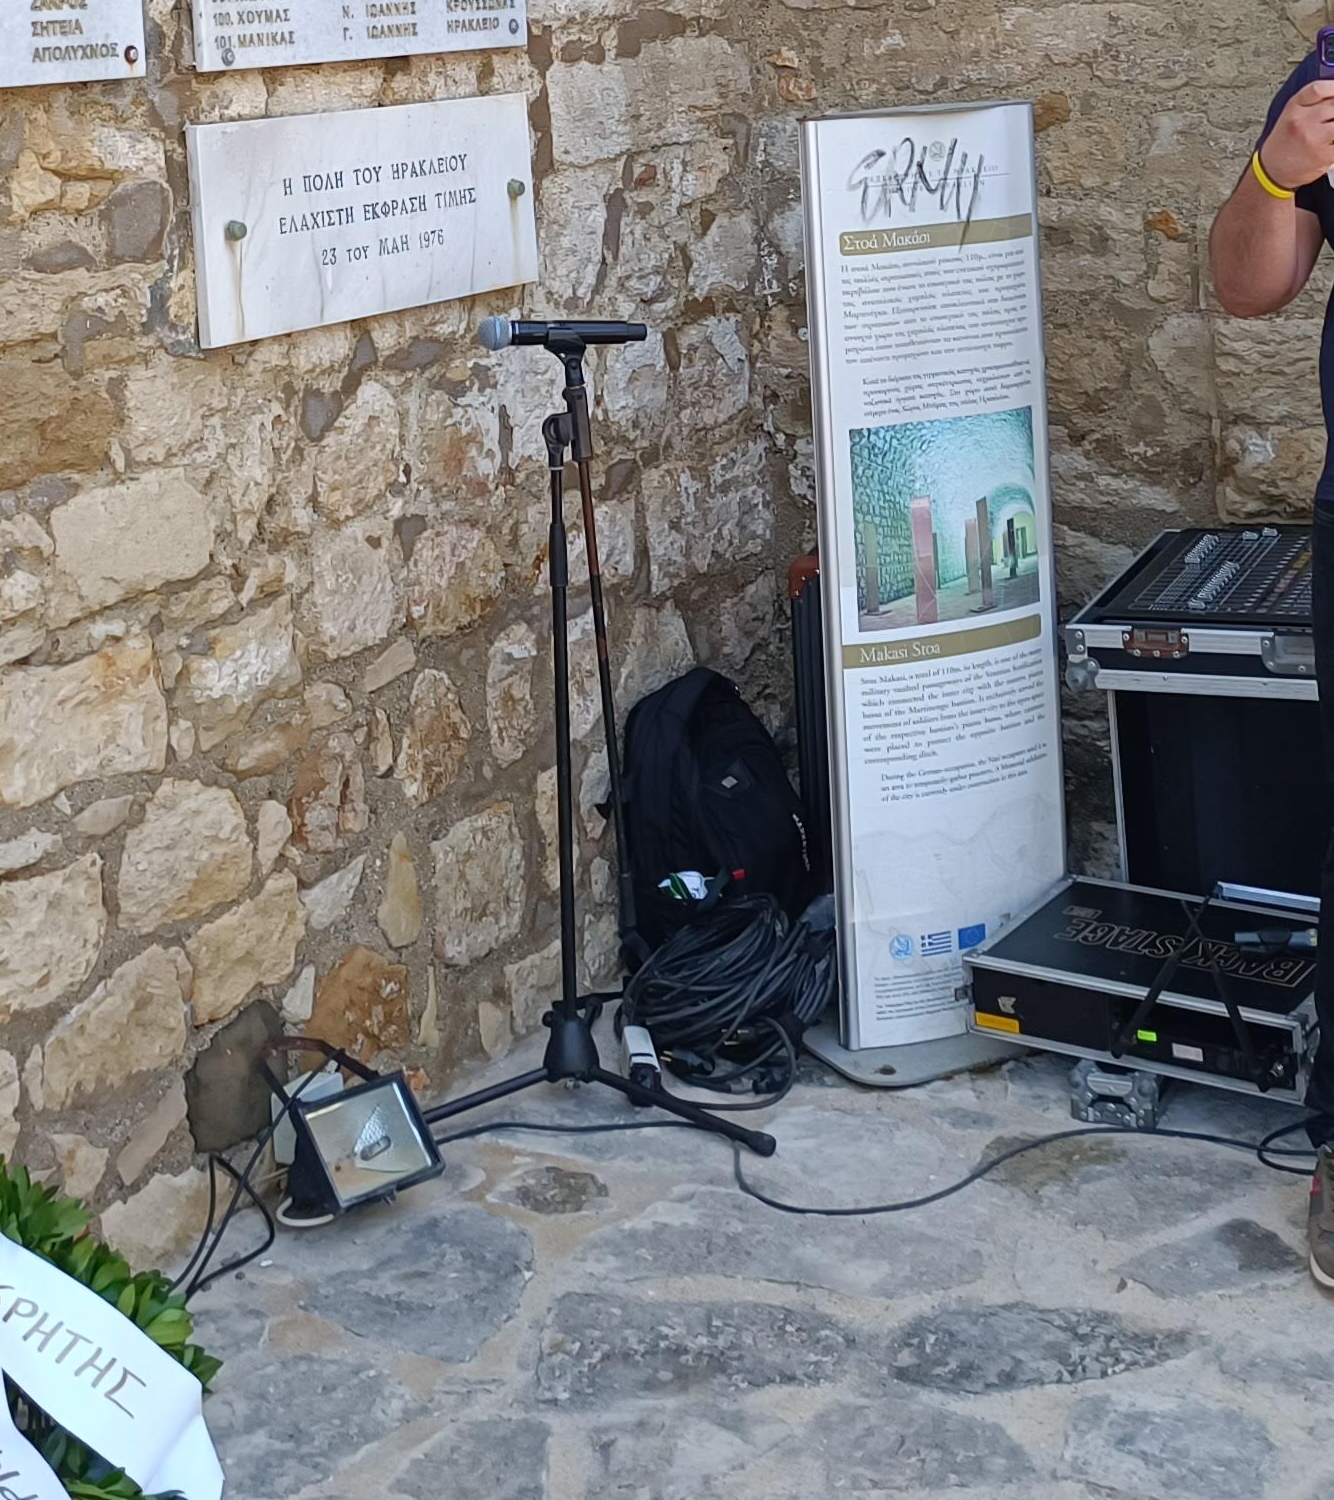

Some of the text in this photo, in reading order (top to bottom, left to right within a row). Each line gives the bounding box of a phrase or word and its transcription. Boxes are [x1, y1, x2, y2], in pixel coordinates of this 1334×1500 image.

[283, 153, 467, 196] Η ΠΟΛΗ ΤΟΥ ΗΡΑΚΛΕΙΟΥ
[279, 188, 476, 234] ΕΛΑΧΙΣΤΗ ΕΚΦΡΑΣΗ ΤΙΜΗΣ
[322, 247, 337, 266] 23
[379, 234, 410, 256] ΜΑΗ
[419, 229, 444, 249] 1976
[843, 230, 931, 251] Στοά Μακάσι
[860, 642, 941, 663] Makasi Stoa
